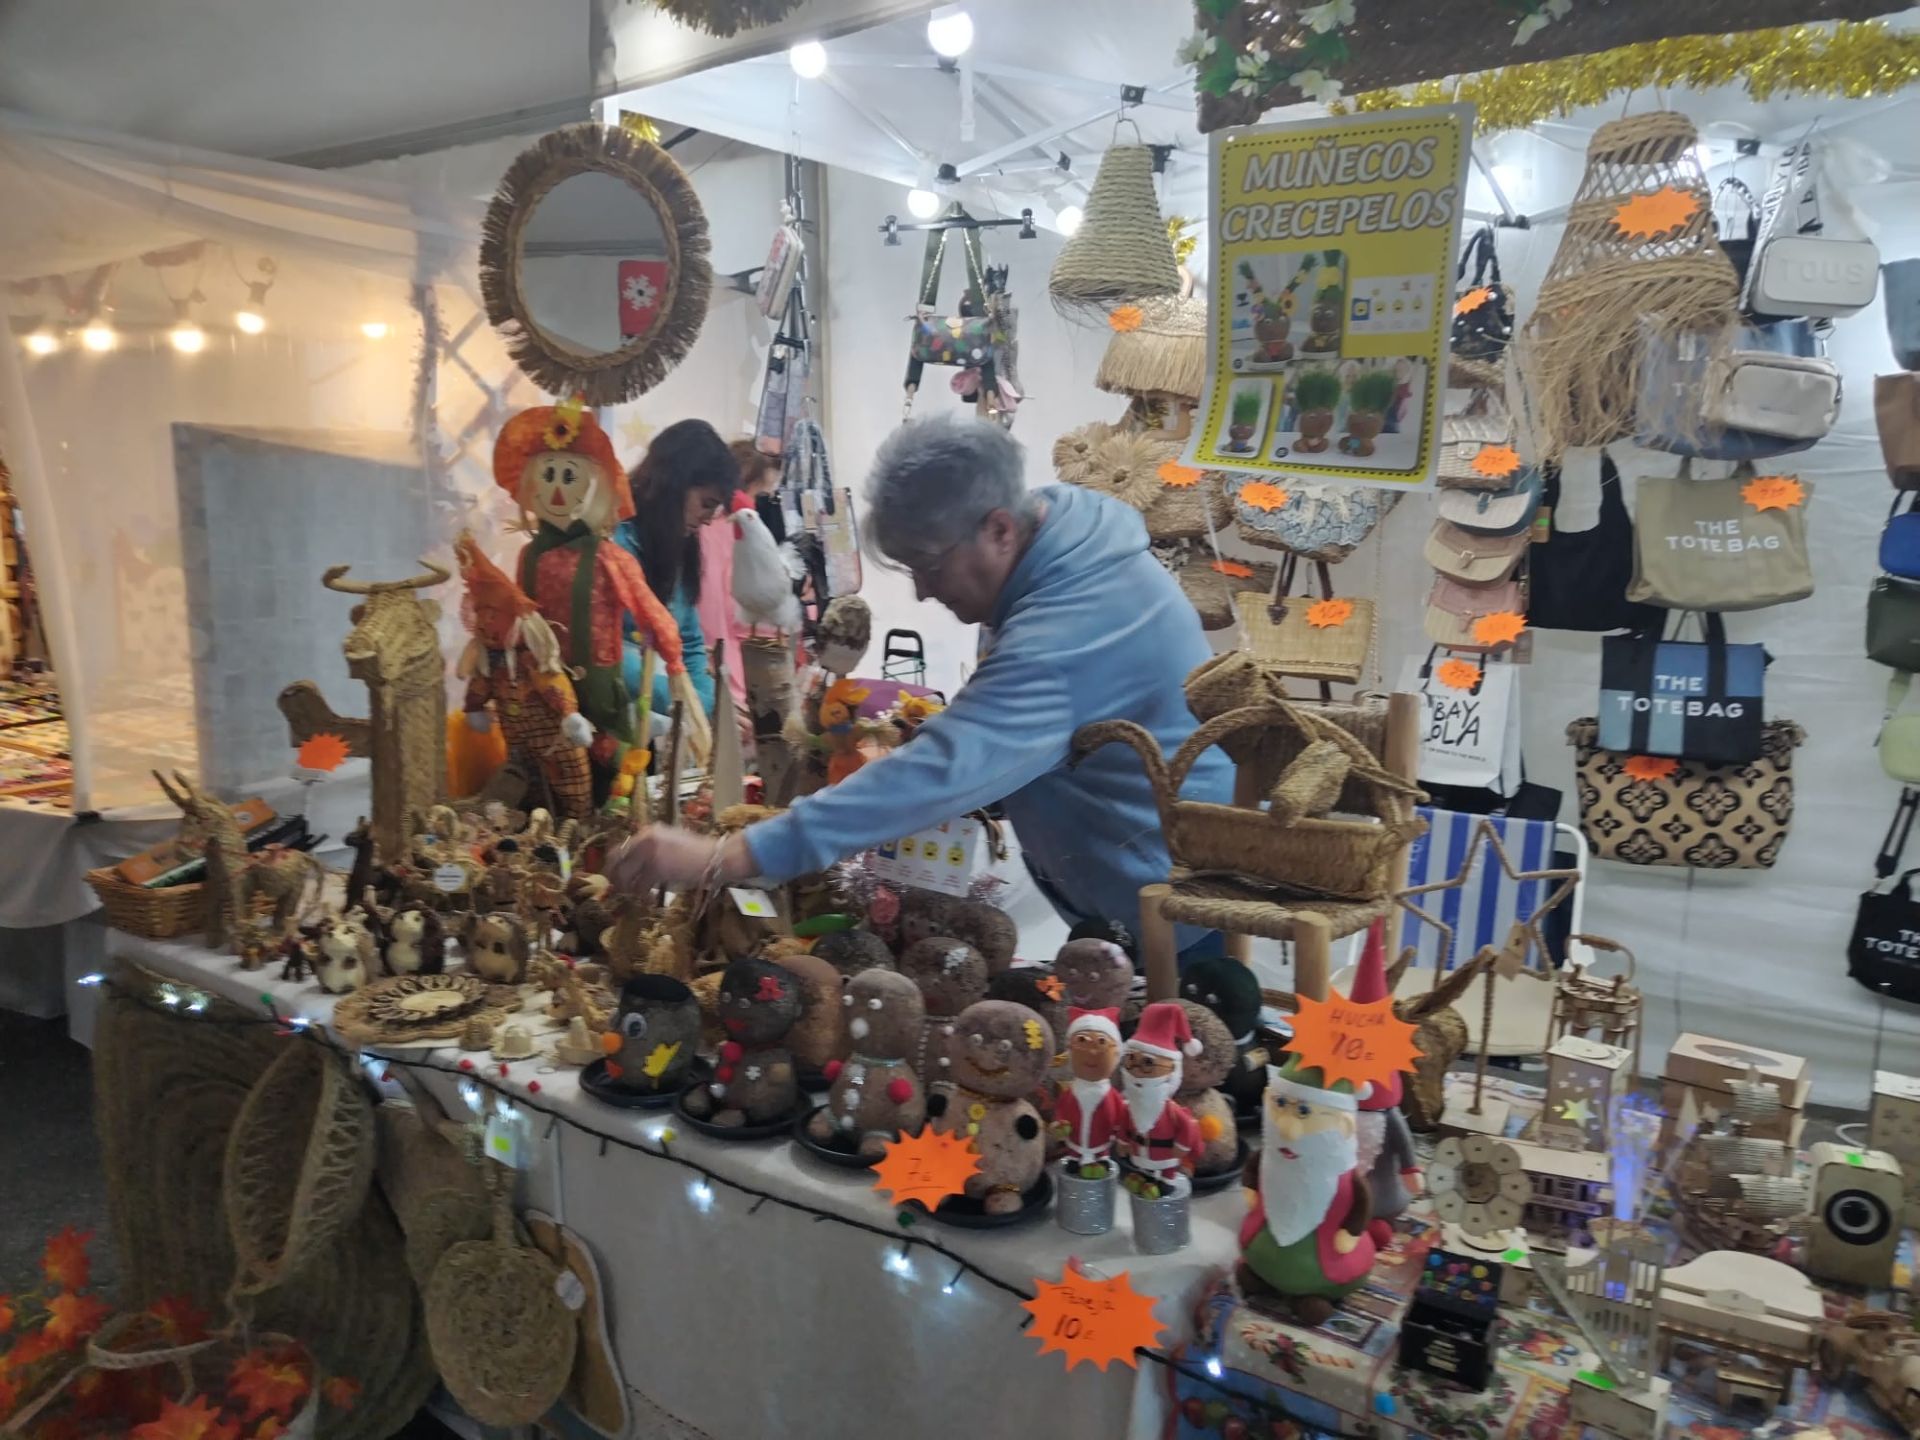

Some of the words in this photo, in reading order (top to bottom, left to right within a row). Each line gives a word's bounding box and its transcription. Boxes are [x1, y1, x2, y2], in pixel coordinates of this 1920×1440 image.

[1242, 136, 1438, 193] MUÑECOS
[1221, 188, 1457, 243] CRECEPELOS
[1780, 258, 1865, 285] TOUS
[1694, 518, 1741, 535] THE
[1664, 534, 1723, 553] TOTE
[1726, 534, 1780, 552] BAG
[1655, 674, 1703, 692] THE
